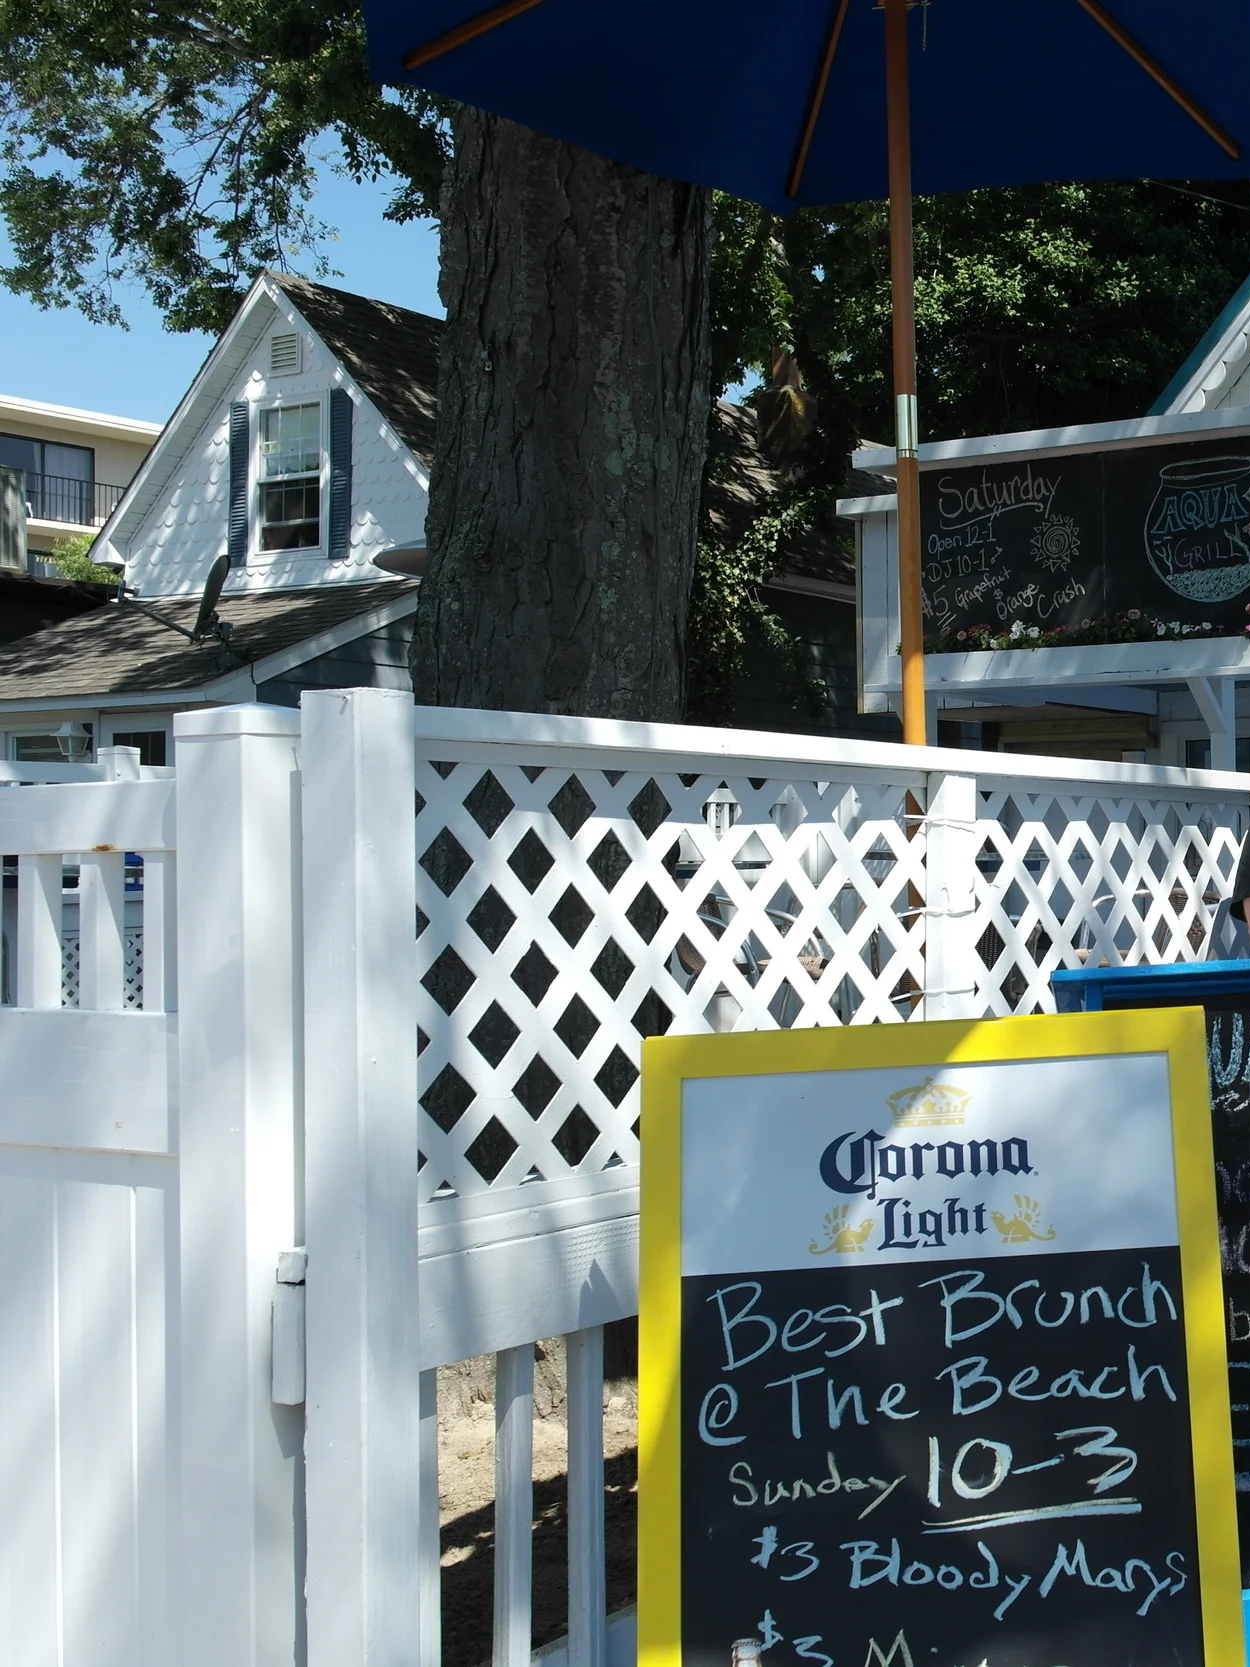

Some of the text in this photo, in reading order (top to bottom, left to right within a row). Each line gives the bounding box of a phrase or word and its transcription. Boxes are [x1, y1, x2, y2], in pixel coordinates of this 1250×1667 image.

[938, 464, 1062, 518] Saturday
[1151, 483, 1249, 534] AQUA
[926, 548, 989, 583] DJ 10-1
[928, 522, 996, 559] Open 12-1
[1174, 538, 1242, 568] GRILL
[954, 566, 1012, 609] Grapefruit
[996, 583, 1040, 620] Orange
[819, 1128, 1034, 1199] Corona
[877, 1197, 989, 1251] Light
[707, 1261, 1179, 1371] Best Brunch
[698, 1345, 1178, 1446] @ The Beach
[729, 1426, 1138, 1520] Sunday 10-3
[751, 1526, 1188, 1620] $3 Bloody Marys
